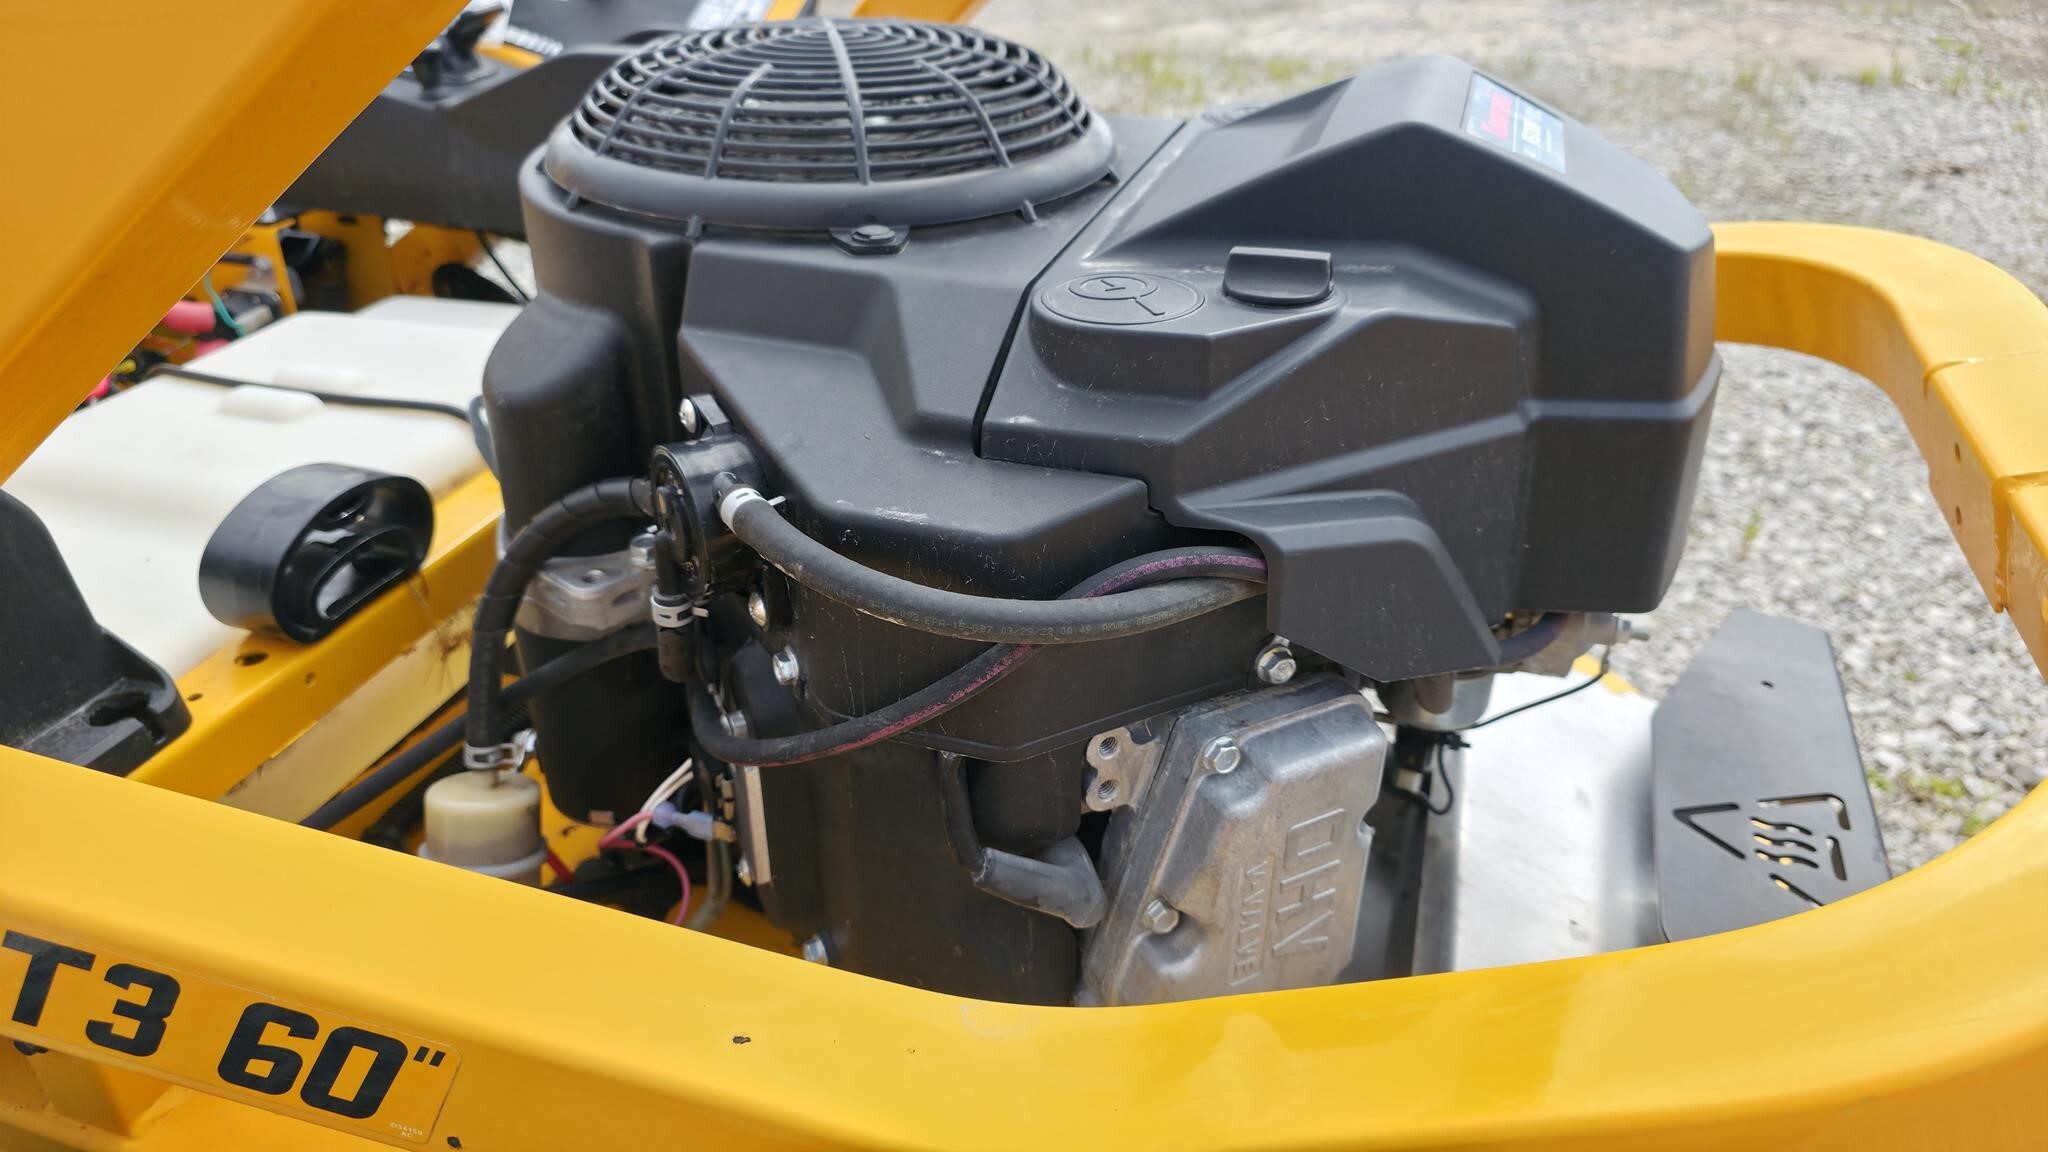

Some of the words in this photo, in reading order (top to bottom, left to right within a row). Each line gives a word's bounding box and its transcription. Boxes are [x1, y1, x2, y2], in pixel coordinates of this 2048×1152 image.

[1233, 860, 1269, 977] V-VALVE
[1271, 806, 1346, 958] OHV
[2, 929, 181, 1057] T3
[217, 1002, 447, 1120] 60"
